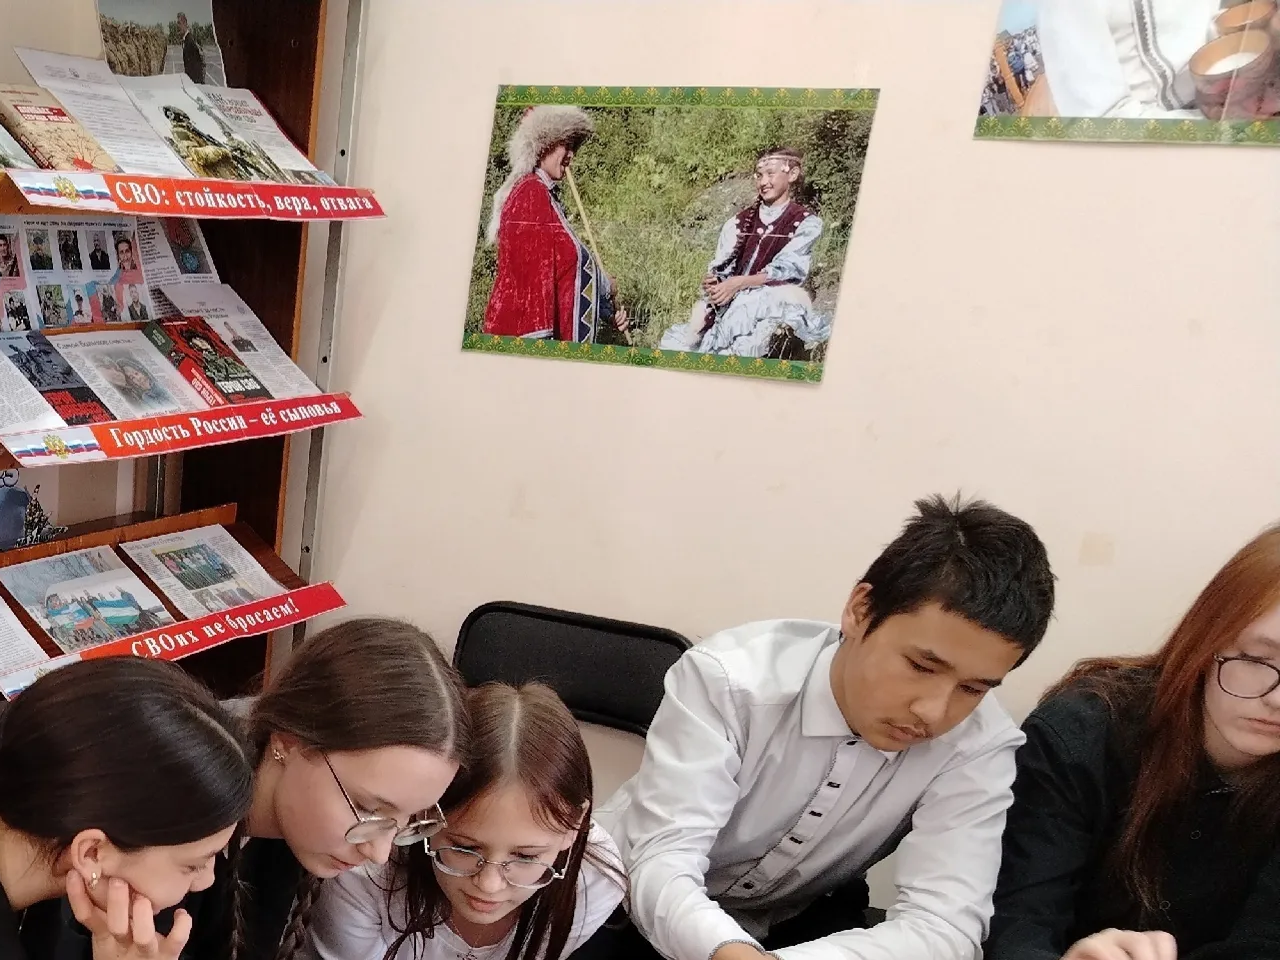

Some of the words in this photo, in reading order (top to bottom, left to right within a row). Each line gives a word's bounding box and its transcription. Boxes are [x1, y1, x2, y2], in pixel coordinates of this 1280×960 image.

[115, 181, 170, 207] СВО:
[175, 187, 272, 213] стойкость,
[274, 194, 318, 215] вера,
[320, 196, 373, 212] отвага
[110, 424, 190, 451] Гордость
[191, 413, 247, 440] России
[260, 406, 278, 426] её
[279, 400, 342, 422] сыновья
[131, 629, 200, 658] СВОих
[201, 620, 225, 638] не
[226, 597, 300, 633] бросаем!
